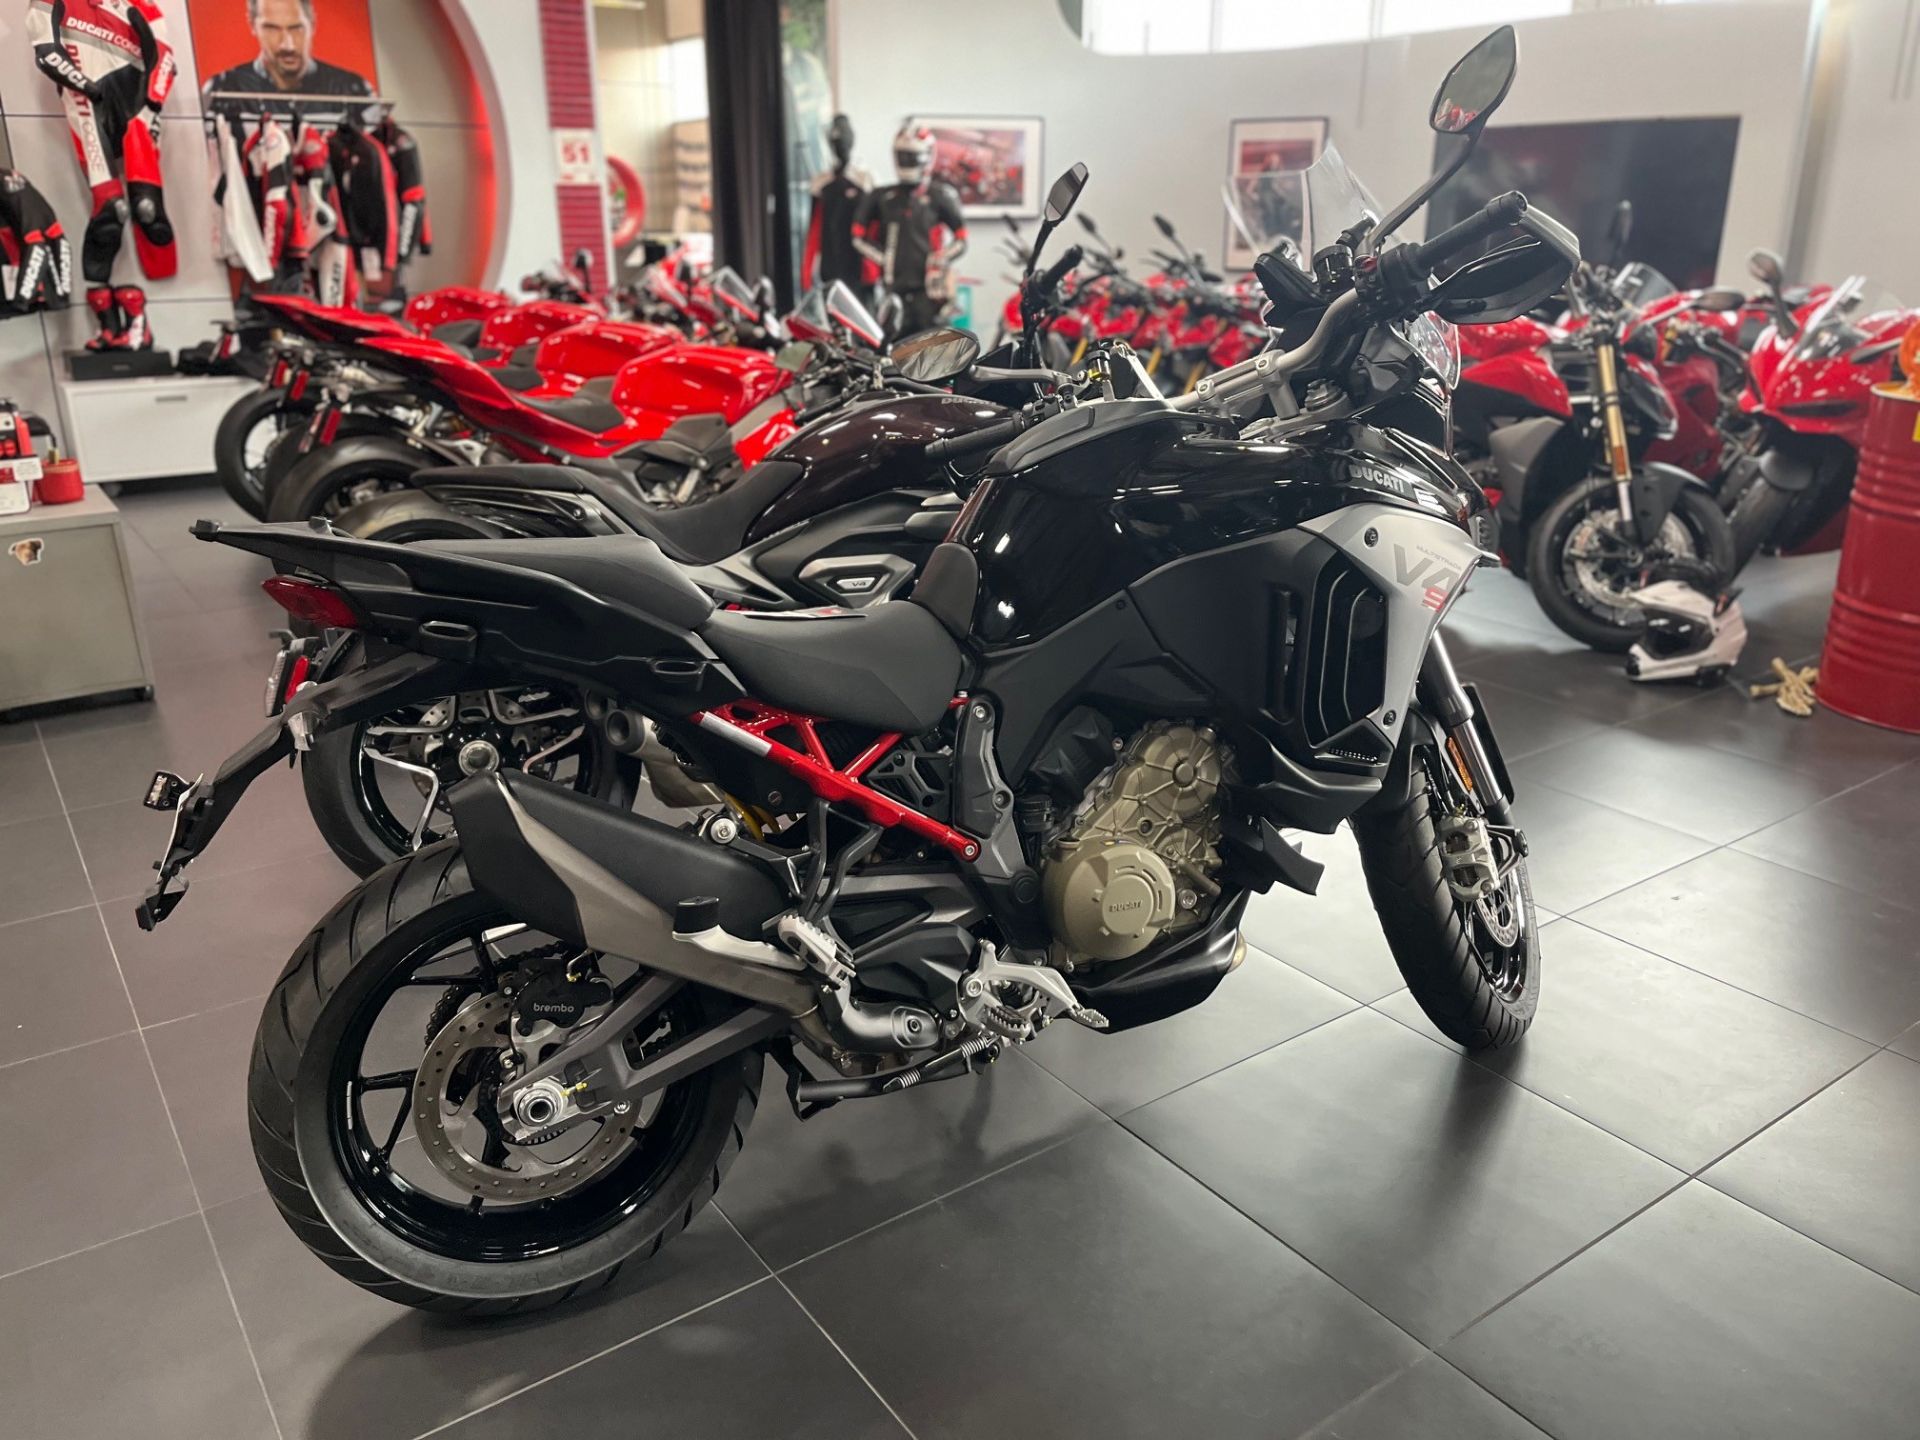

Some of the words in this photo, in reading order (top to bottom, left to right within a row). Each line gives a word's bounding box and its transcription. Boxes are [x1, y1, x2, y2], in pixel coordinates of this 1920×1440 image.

[66, 16, 115, 42] DUCATI
[562, 142, 590, 164] 51
[20, 244, 46, 300] DUCATI
[1348, 464, 1405, 493] DUCATI
[1393, 543, 1460, 592] V4
[1108, 900, 1143, 912] DUCATI
[533, 1002, 575, 1013] brembo
